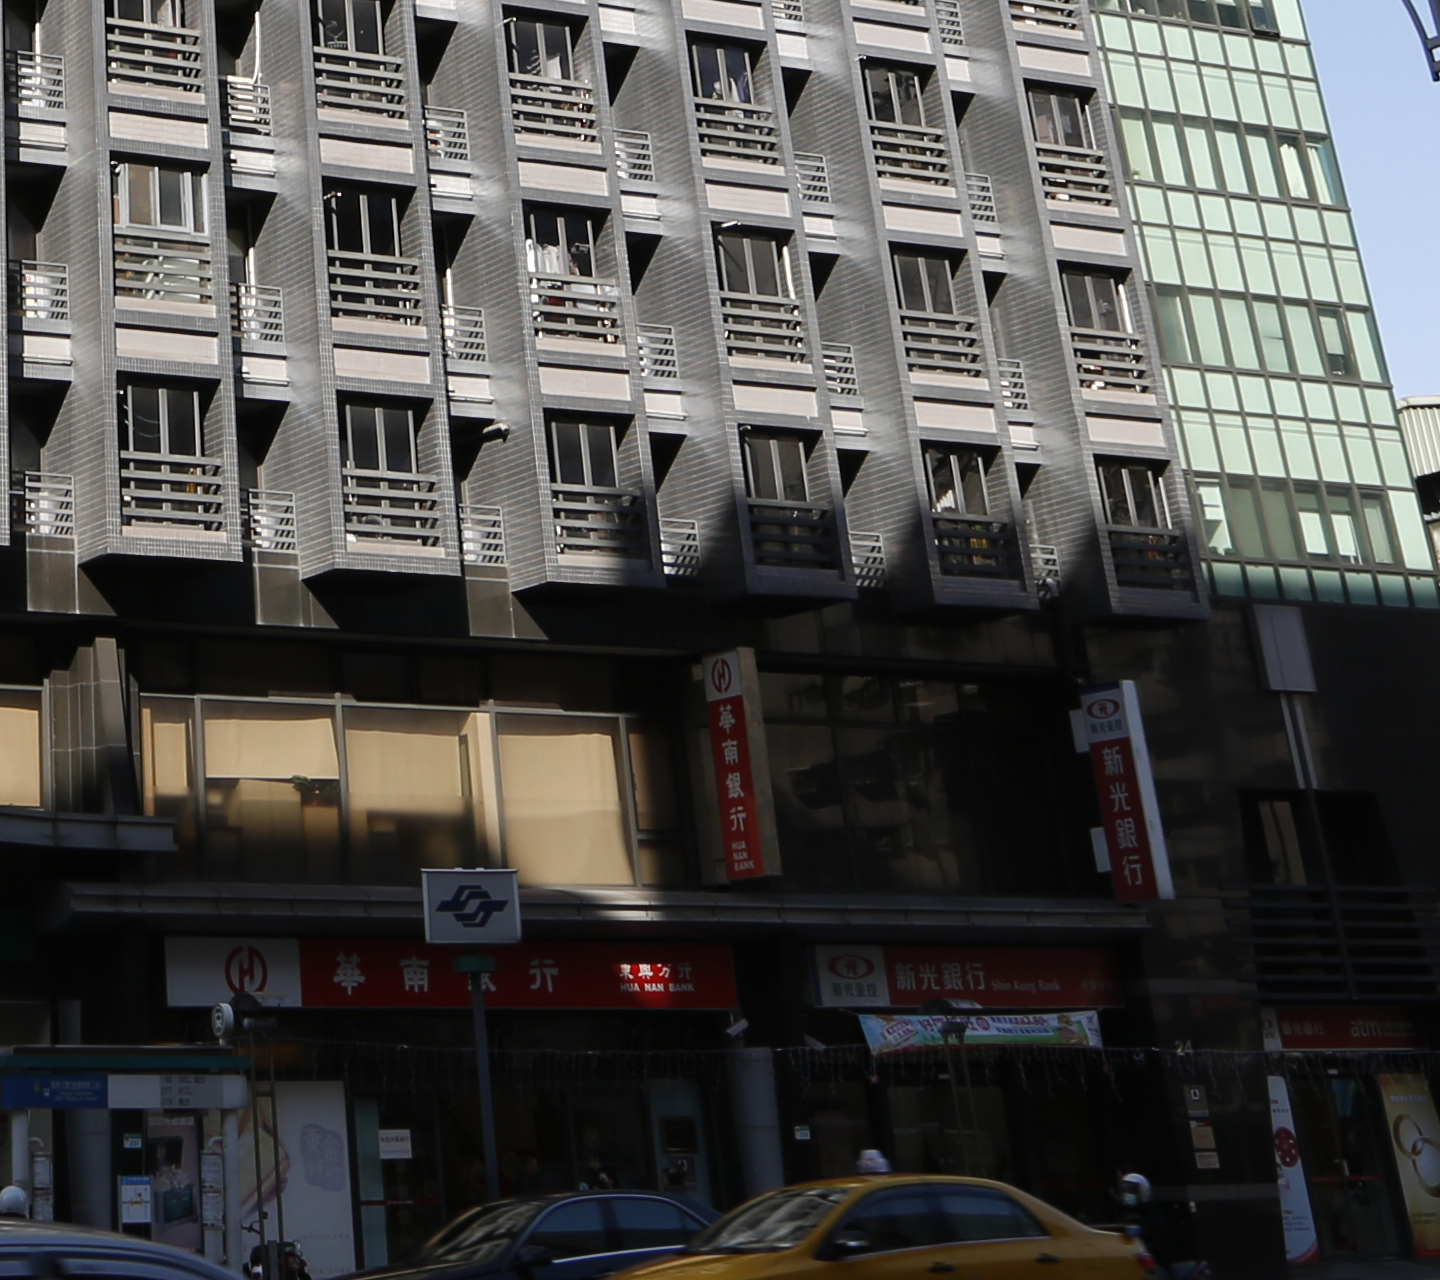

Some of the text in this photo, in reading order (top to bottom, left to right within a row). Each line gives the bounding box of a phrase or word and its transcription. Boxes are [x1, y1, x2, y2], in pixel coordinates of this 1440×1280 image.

[719, 702, 748, 833] 華南銀行
[1102, 745, 1143, 887] 新光銀行
[731, 841, 747, 851] HUA
[732, 851, 749, 861] NAN
[733, 860, 756, 872] BANK
[894, 962, 986, 991] 新光銀行
[619, 981, 695, 993] HUA NAN BANK
[1350, 1019, 1383, 1038] atm
